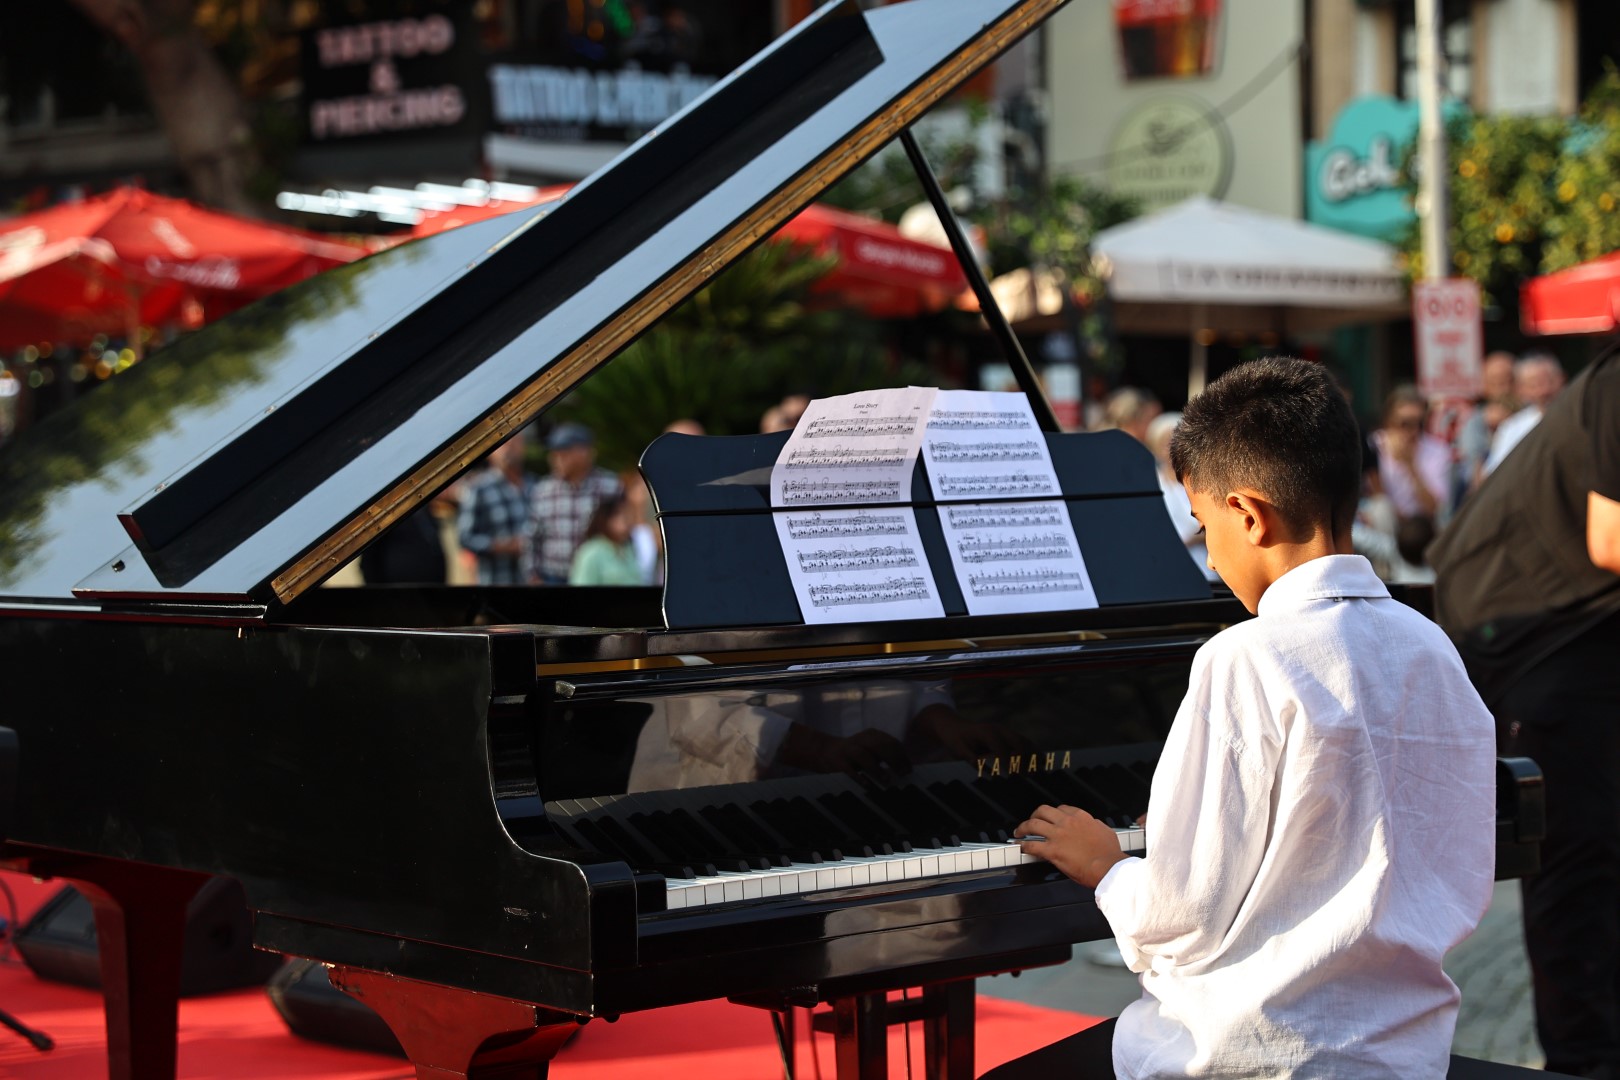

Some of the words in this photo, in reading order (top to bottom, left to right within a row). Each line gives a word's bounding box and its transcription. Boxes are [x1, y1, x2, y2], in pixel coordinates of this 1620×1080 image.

[317, 17, 453, 66] TATTOO
[372, 61, 399, 93] &
[312, 86, 464, 137] PIERCING
[977, 751, 1071, 777] YAMAHA
